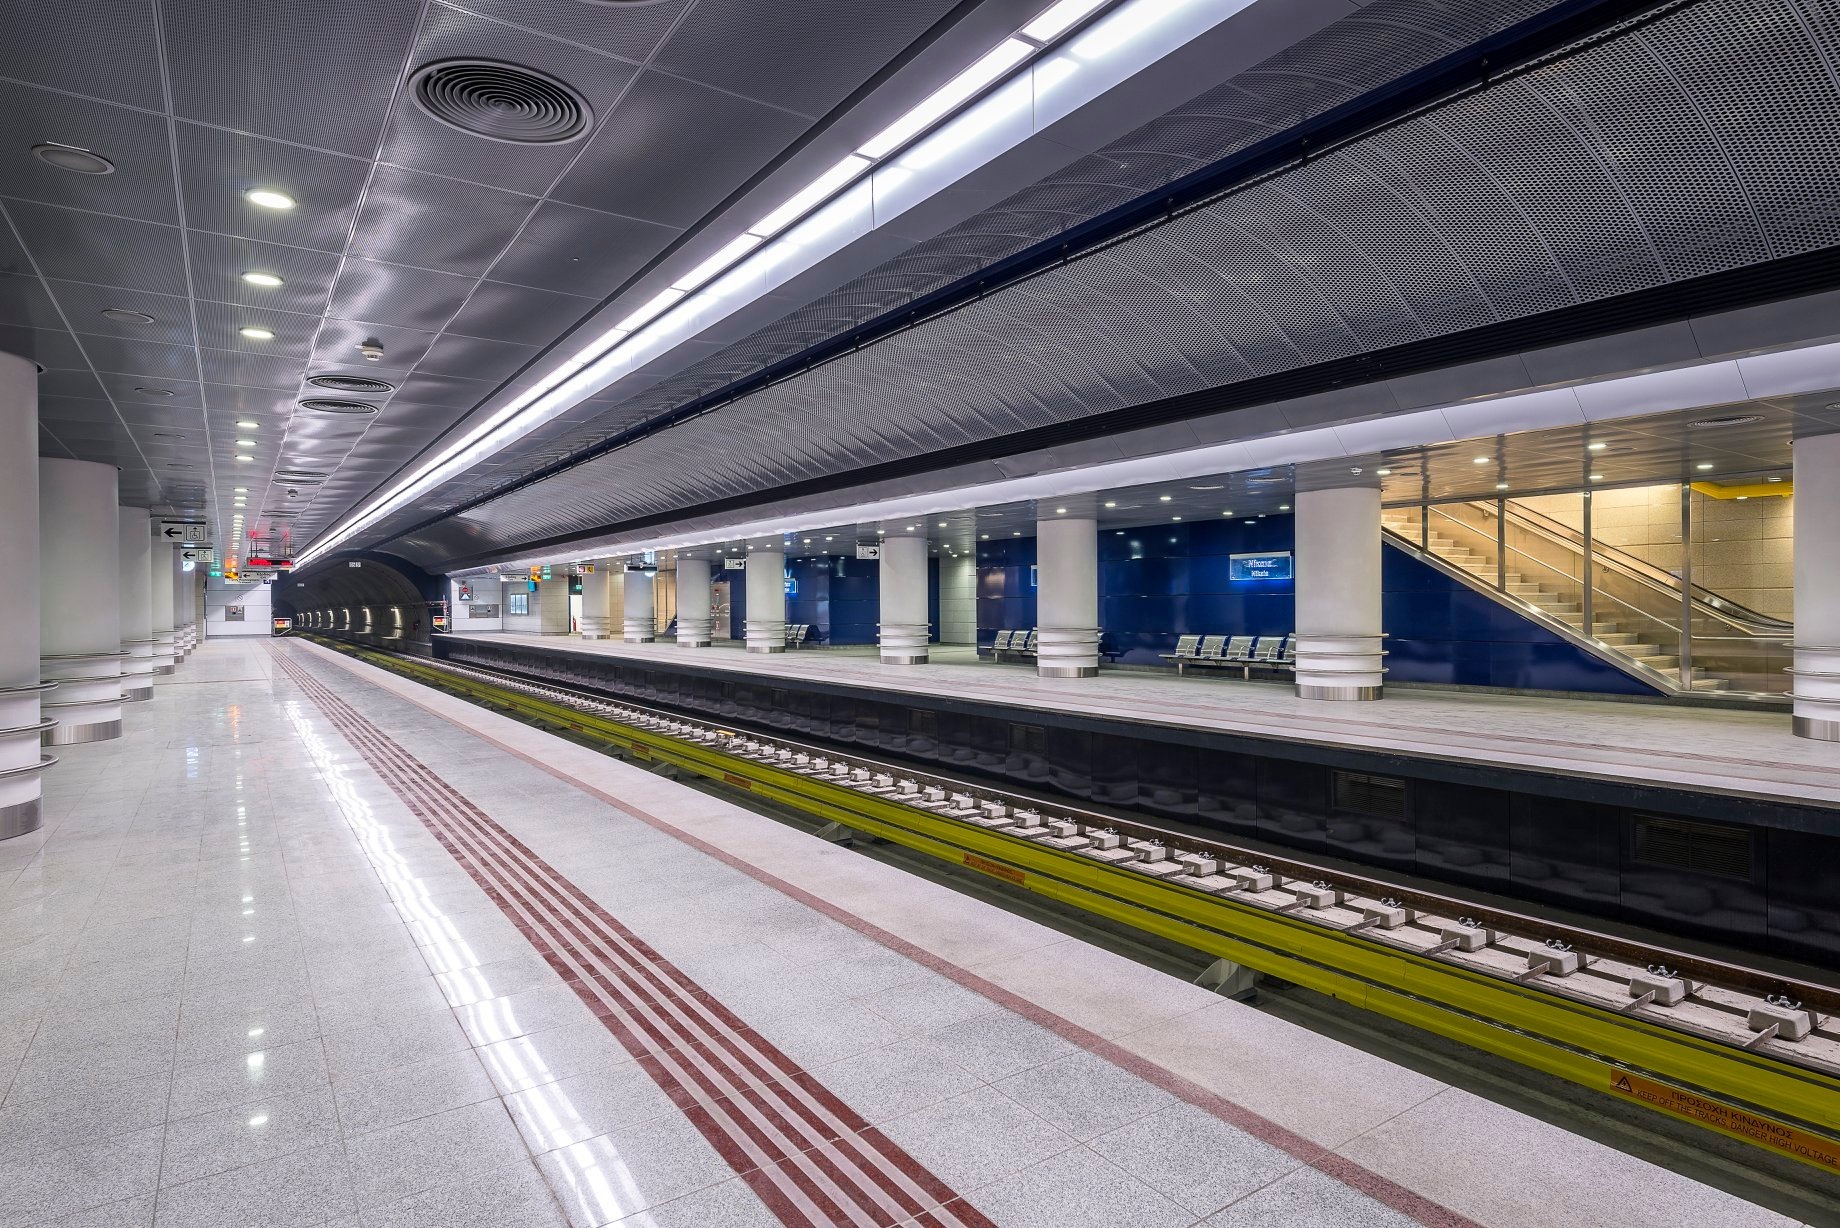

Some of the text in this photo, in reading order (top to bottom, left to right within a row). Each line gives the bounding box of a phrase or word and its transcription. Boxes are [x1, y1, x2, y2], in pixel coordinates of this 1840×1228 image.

[1637, 1089, 1658, 1102] KEEP
[1659, 1097, 1675, 1107] OFF
[1731, 1121, 1768, 1140] DANGER
[1769, 1135, 1792, 1150] HIGH
[1794, 1144, 1839, 1166] VOLTAGE
[1672, 1091, 1793, 1140] ΠΡΟΣΟΧΗ ΚΙΝΔΥΝΟΣ
